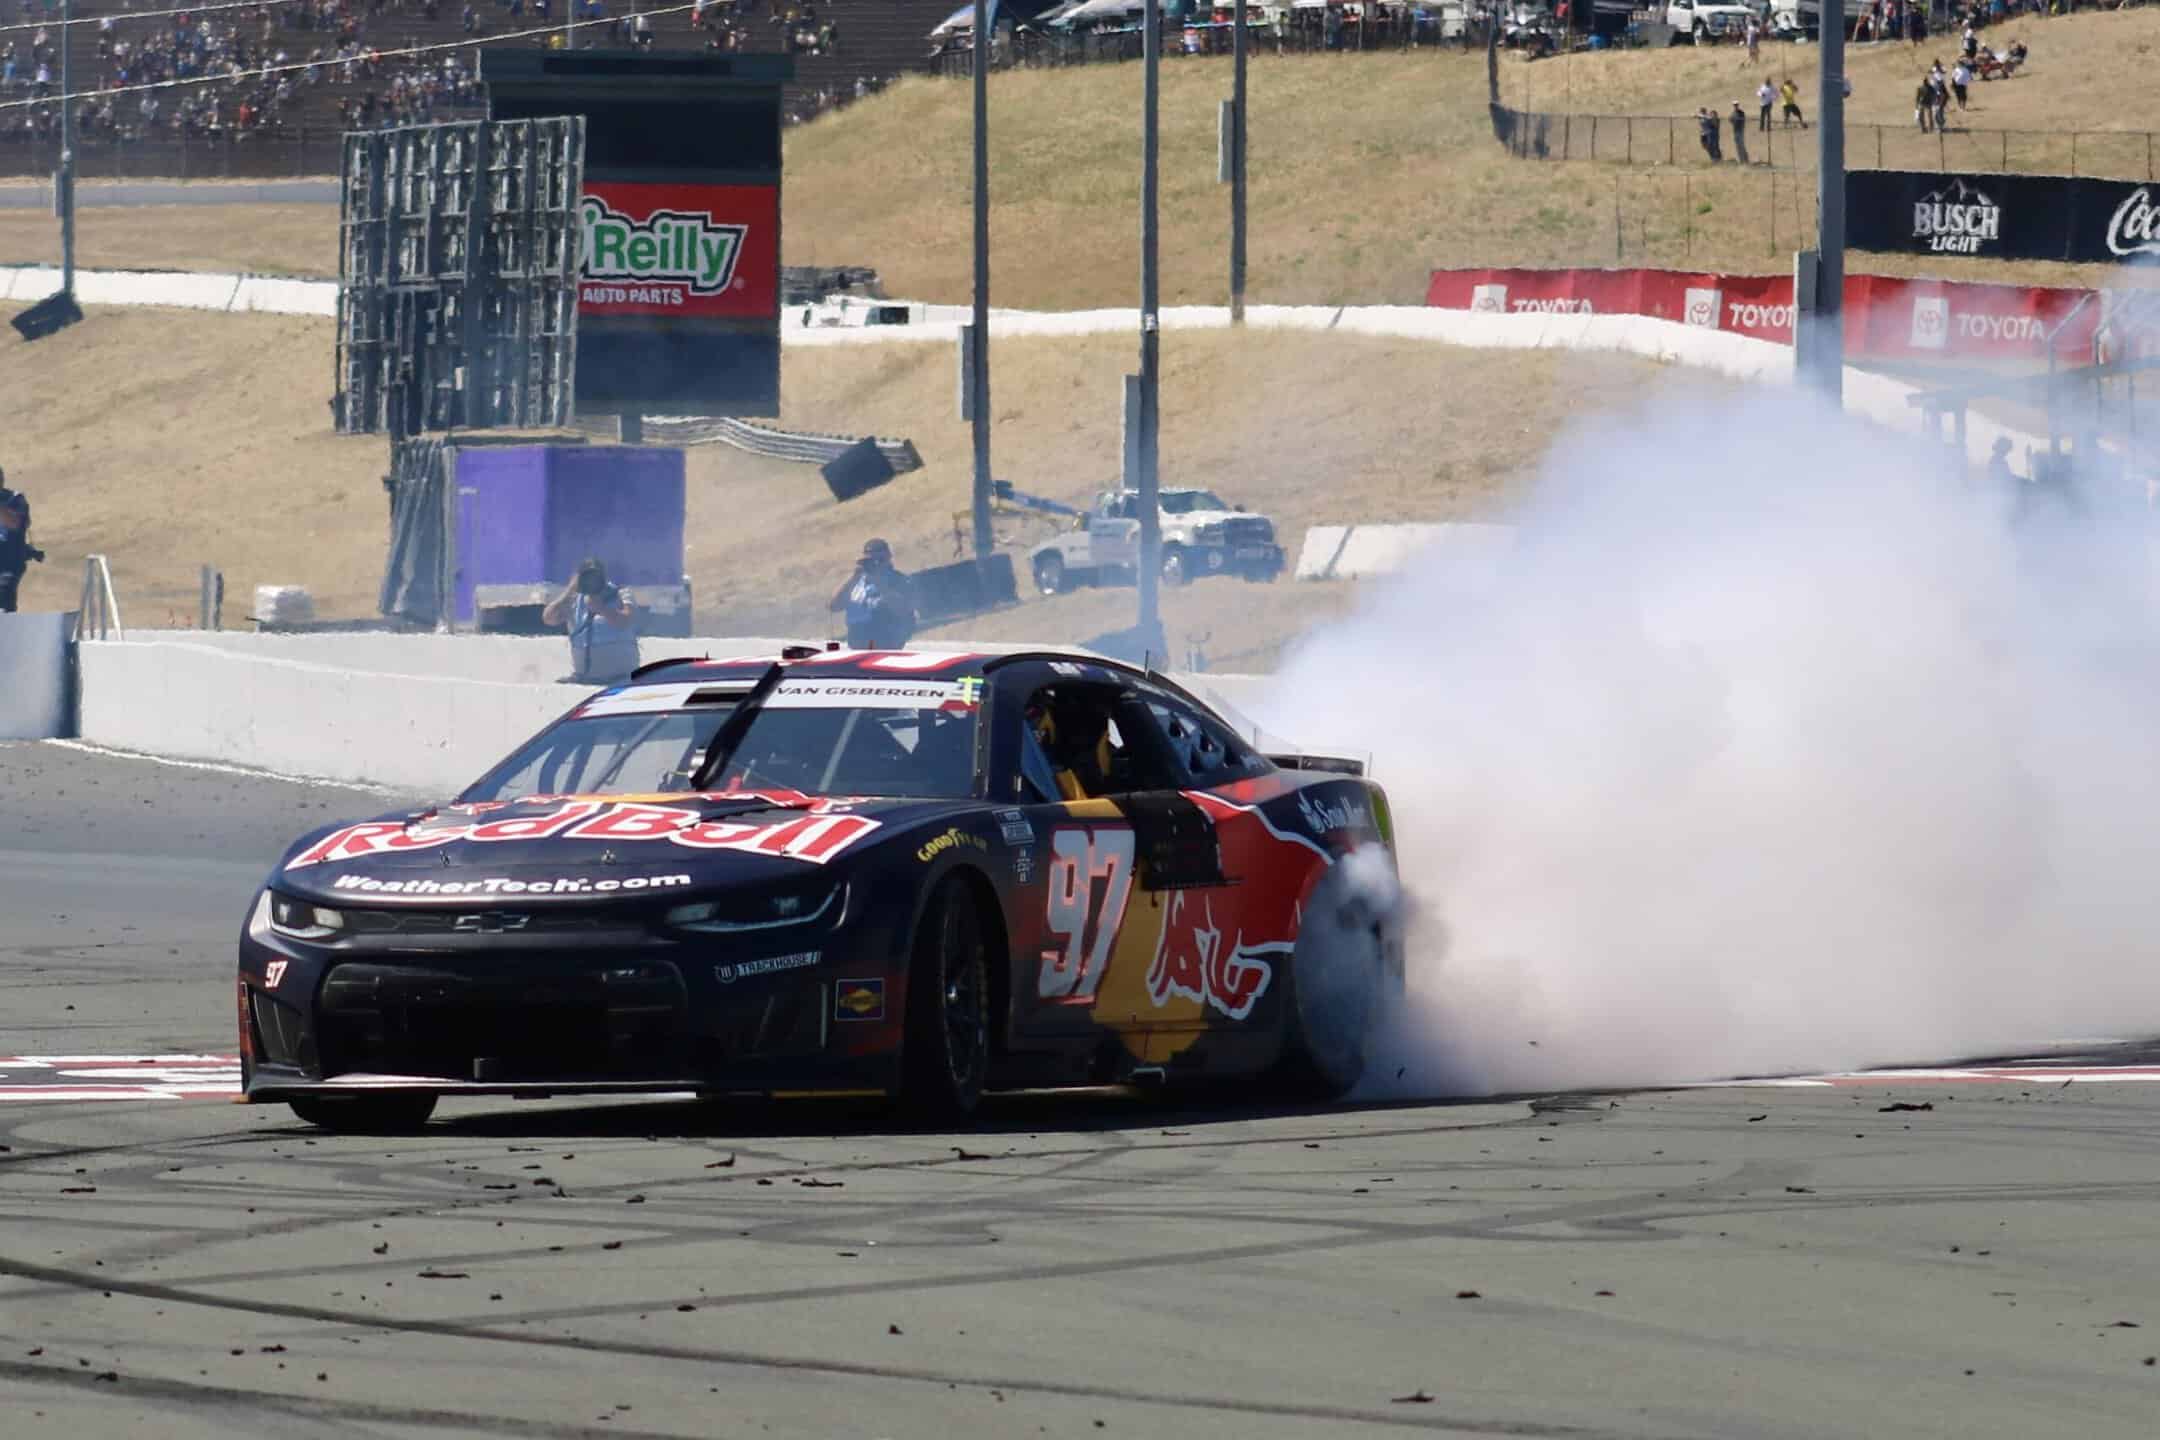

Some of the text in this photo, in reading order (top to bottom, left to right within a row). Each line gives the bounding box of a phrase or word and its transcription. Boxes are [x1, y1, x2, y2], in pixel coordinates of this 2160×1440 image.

[1913, 202, 1999, 239] BUSCH
[1930, 236, 1979, 252] LIGHT
[583, 287, 684, 304] AUTO PARTS
[1956, 314, 2046, 341] TOYOTA
[777, 687, 944, 698] VAN GISBERGEN
[1038, 836, 1136, 1005] 97
[264, 960, 289, 988] 97
